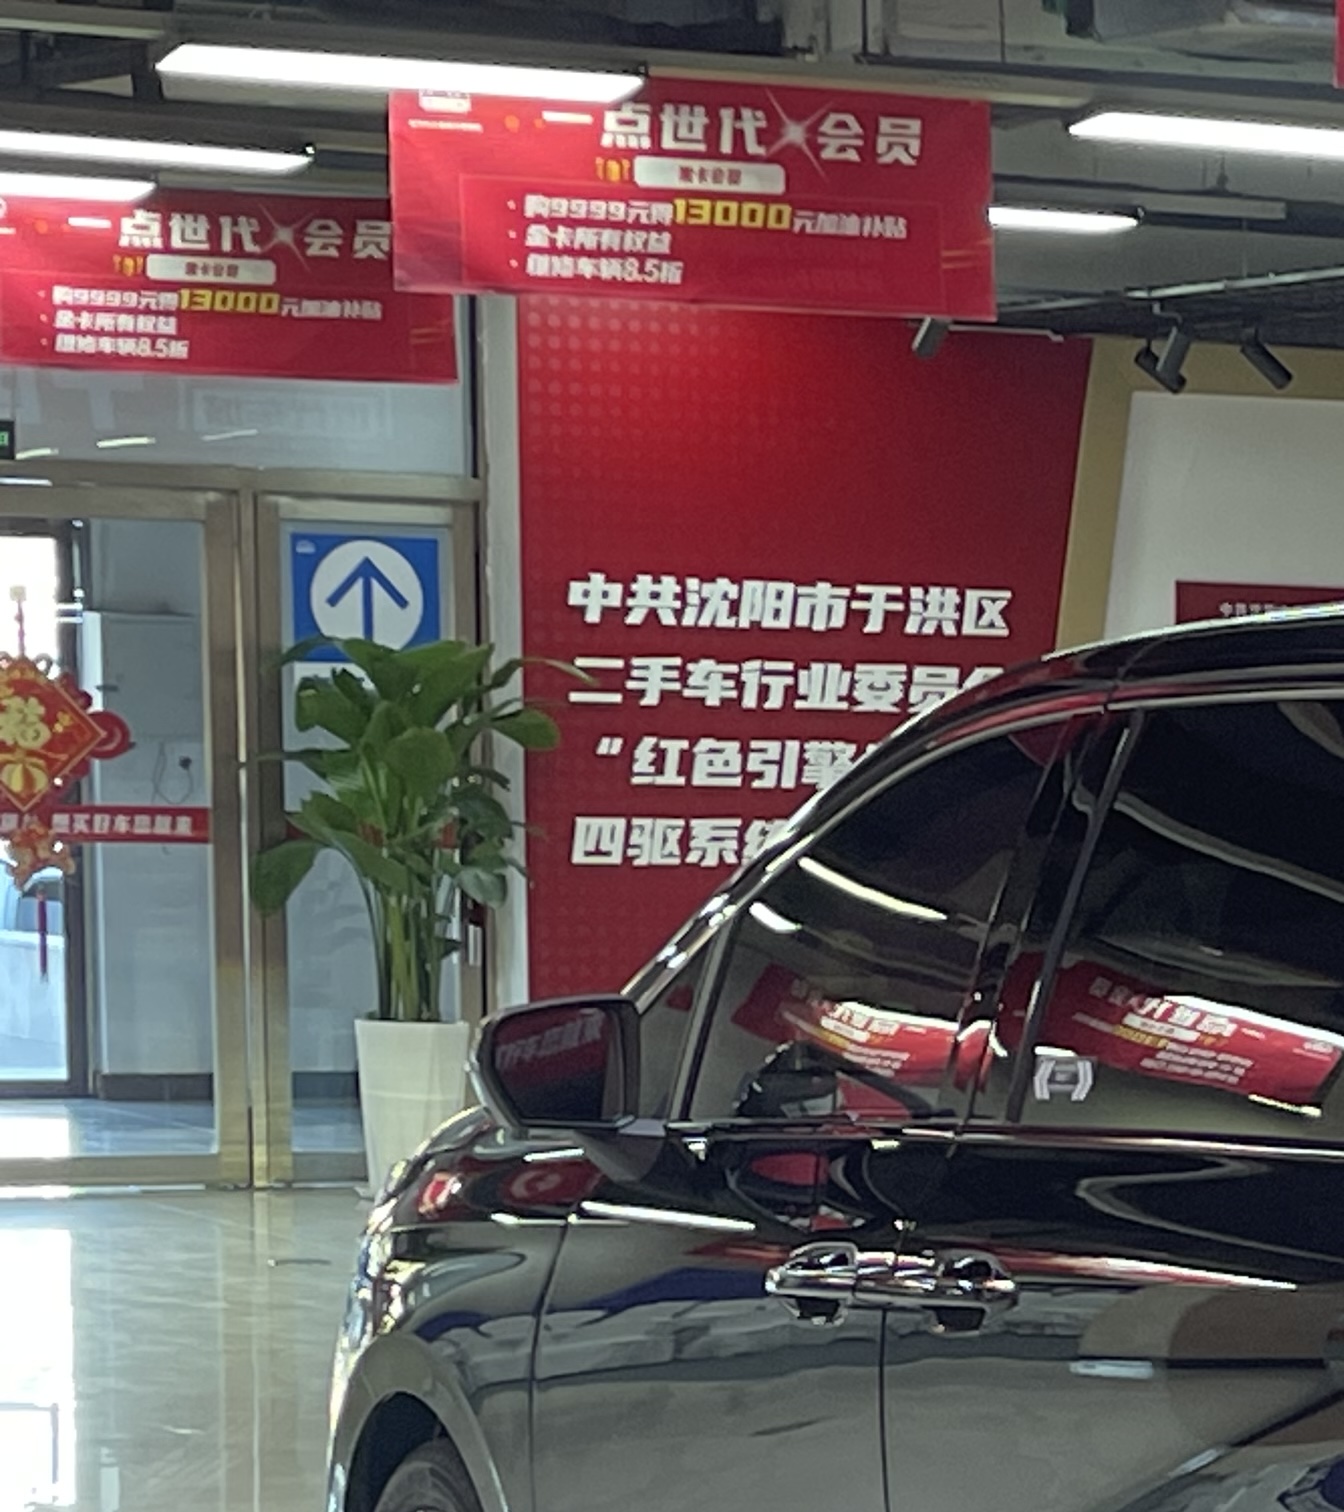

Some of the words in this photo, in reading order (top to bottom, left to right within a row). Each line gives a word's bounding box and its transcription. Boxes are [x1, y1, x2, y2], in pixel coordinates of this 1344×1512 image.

[817, 111, 923, 167] 会员
[303, 218, 392, 261] 会员
[567, 572, 1013, 637] 中共沈阳市于洪区
